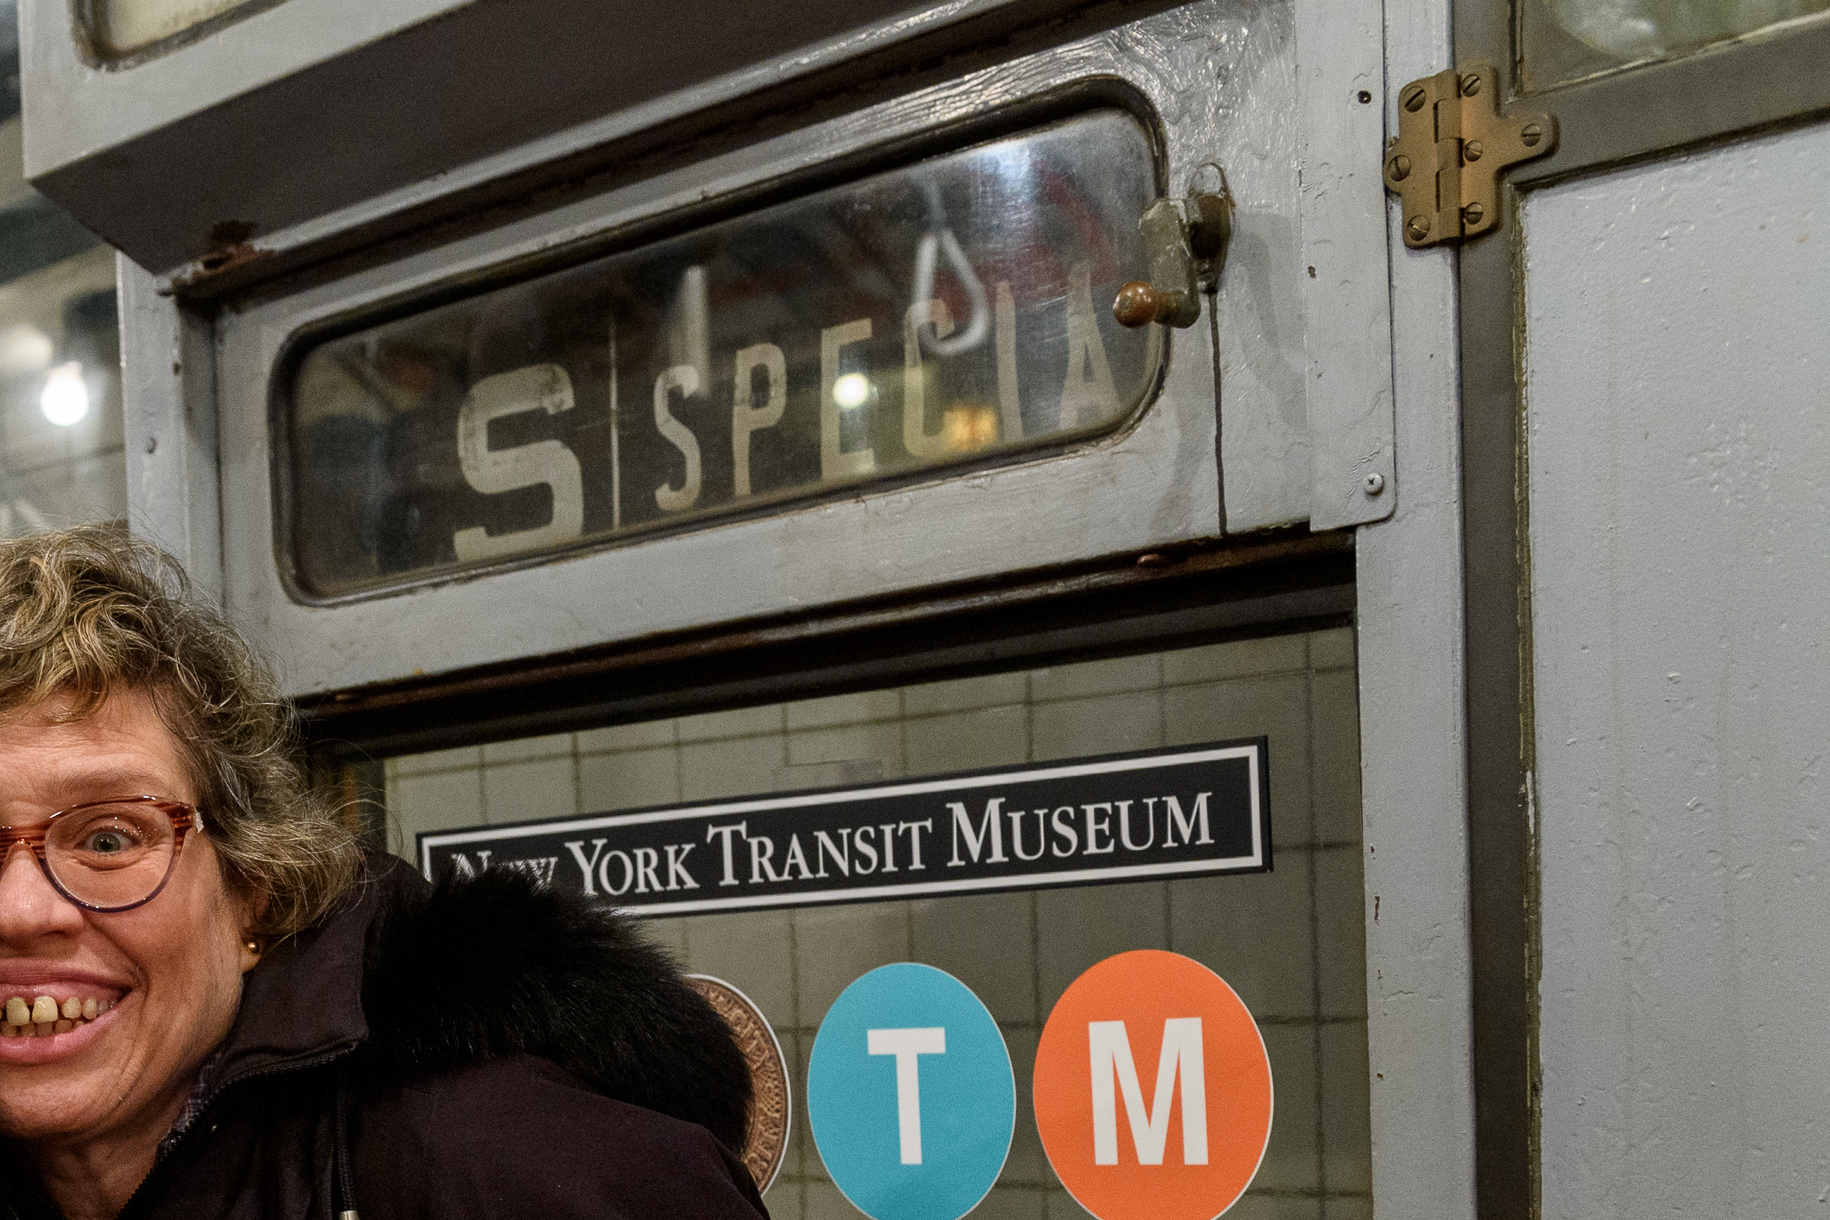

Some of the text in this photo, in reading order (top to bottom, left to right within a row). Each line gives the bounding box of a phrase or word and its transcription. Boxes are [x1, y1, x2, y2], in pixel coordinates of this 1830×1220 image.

[454, 362, 584, 563] S
[564, 838, 701, 898] YORK
[708, 817, 933, 889] TRANSIT
[947, 790, 1215, 869] MUSEUM
[866, 1026, 947, 1166] T
[1088, 1016, 1210, 1166] M
